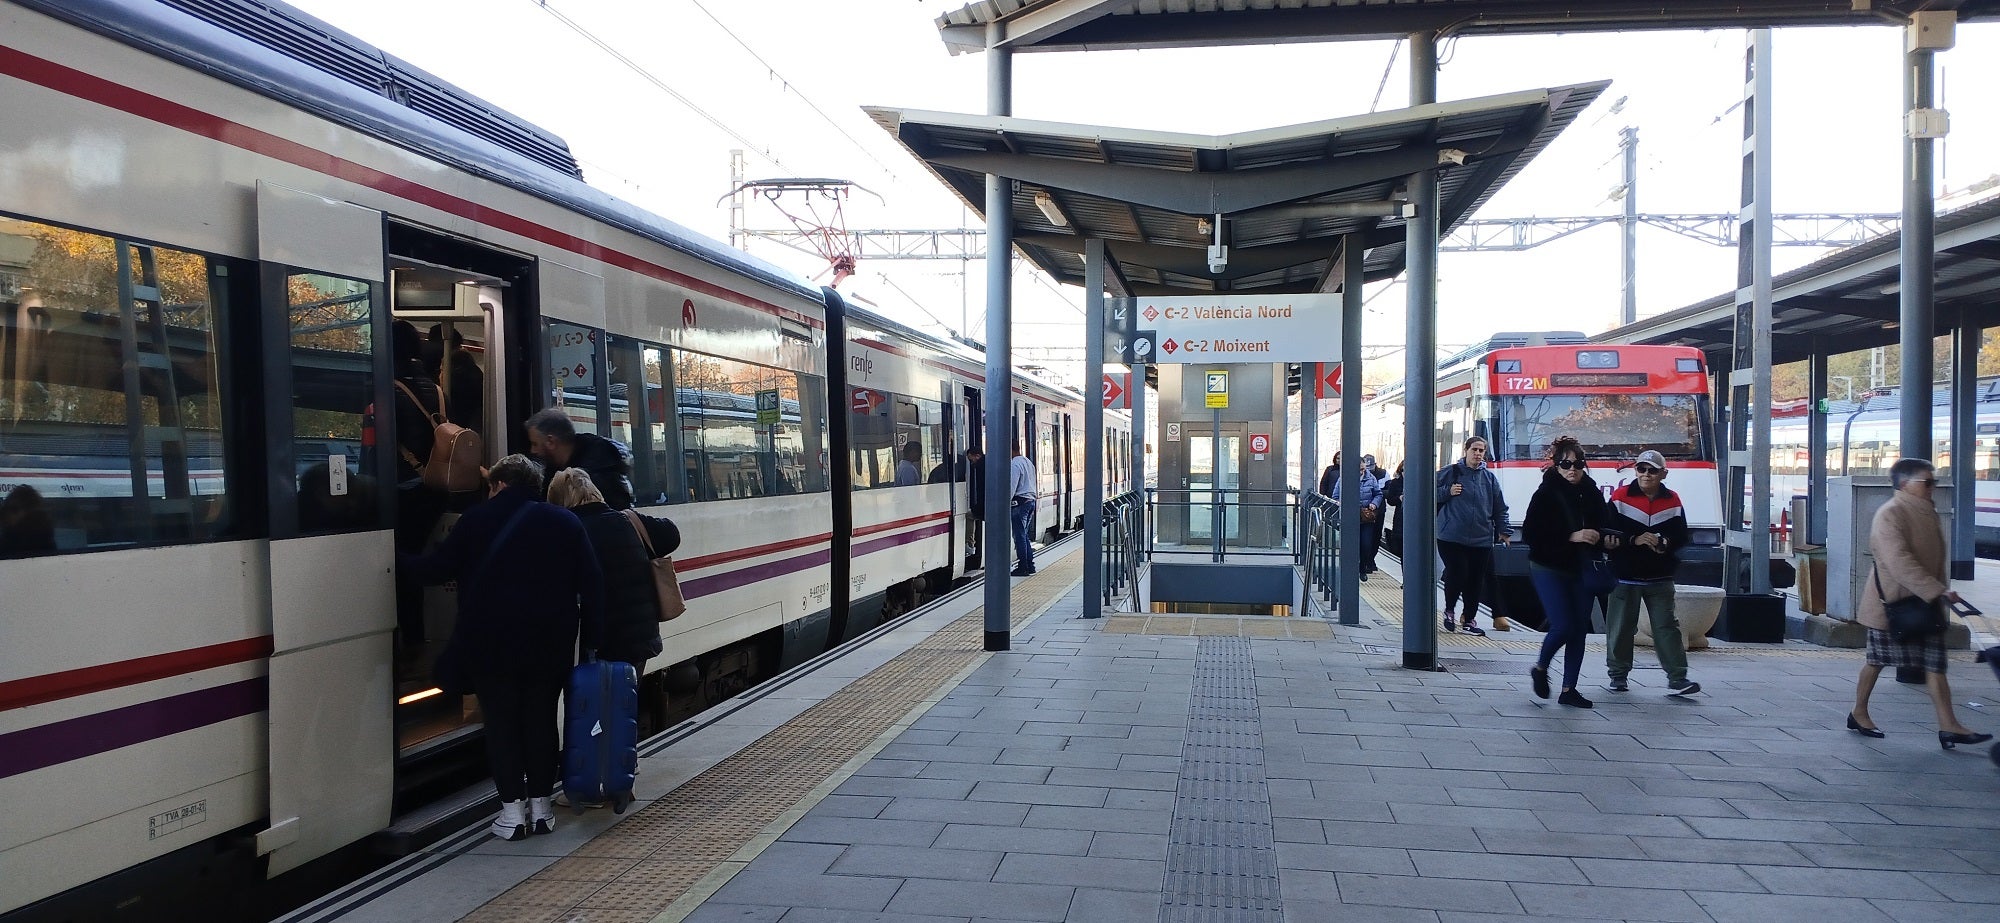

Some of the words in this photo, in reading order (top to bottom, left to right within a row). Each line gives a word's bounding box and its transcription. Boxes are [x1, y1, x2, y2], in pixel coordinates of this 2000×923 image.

[1148, 309, 1154, 319] 2
[1164, 307, 1189, 319] C-2
[1194, 305, 1252, 319] València
[1258, 304, 1292, 318] Nord
[1166, 342, 1173, 351] 1
[1184, 340, 1208, 352] C-2
[1213, 338, 1270, 352] Moixent
[851, 350, 873, 382] renfe
[1103, 381, 1112, 400] 2
[1506, 377, 1548, 390] 172M
[165, 810, 179, 821] TVA
